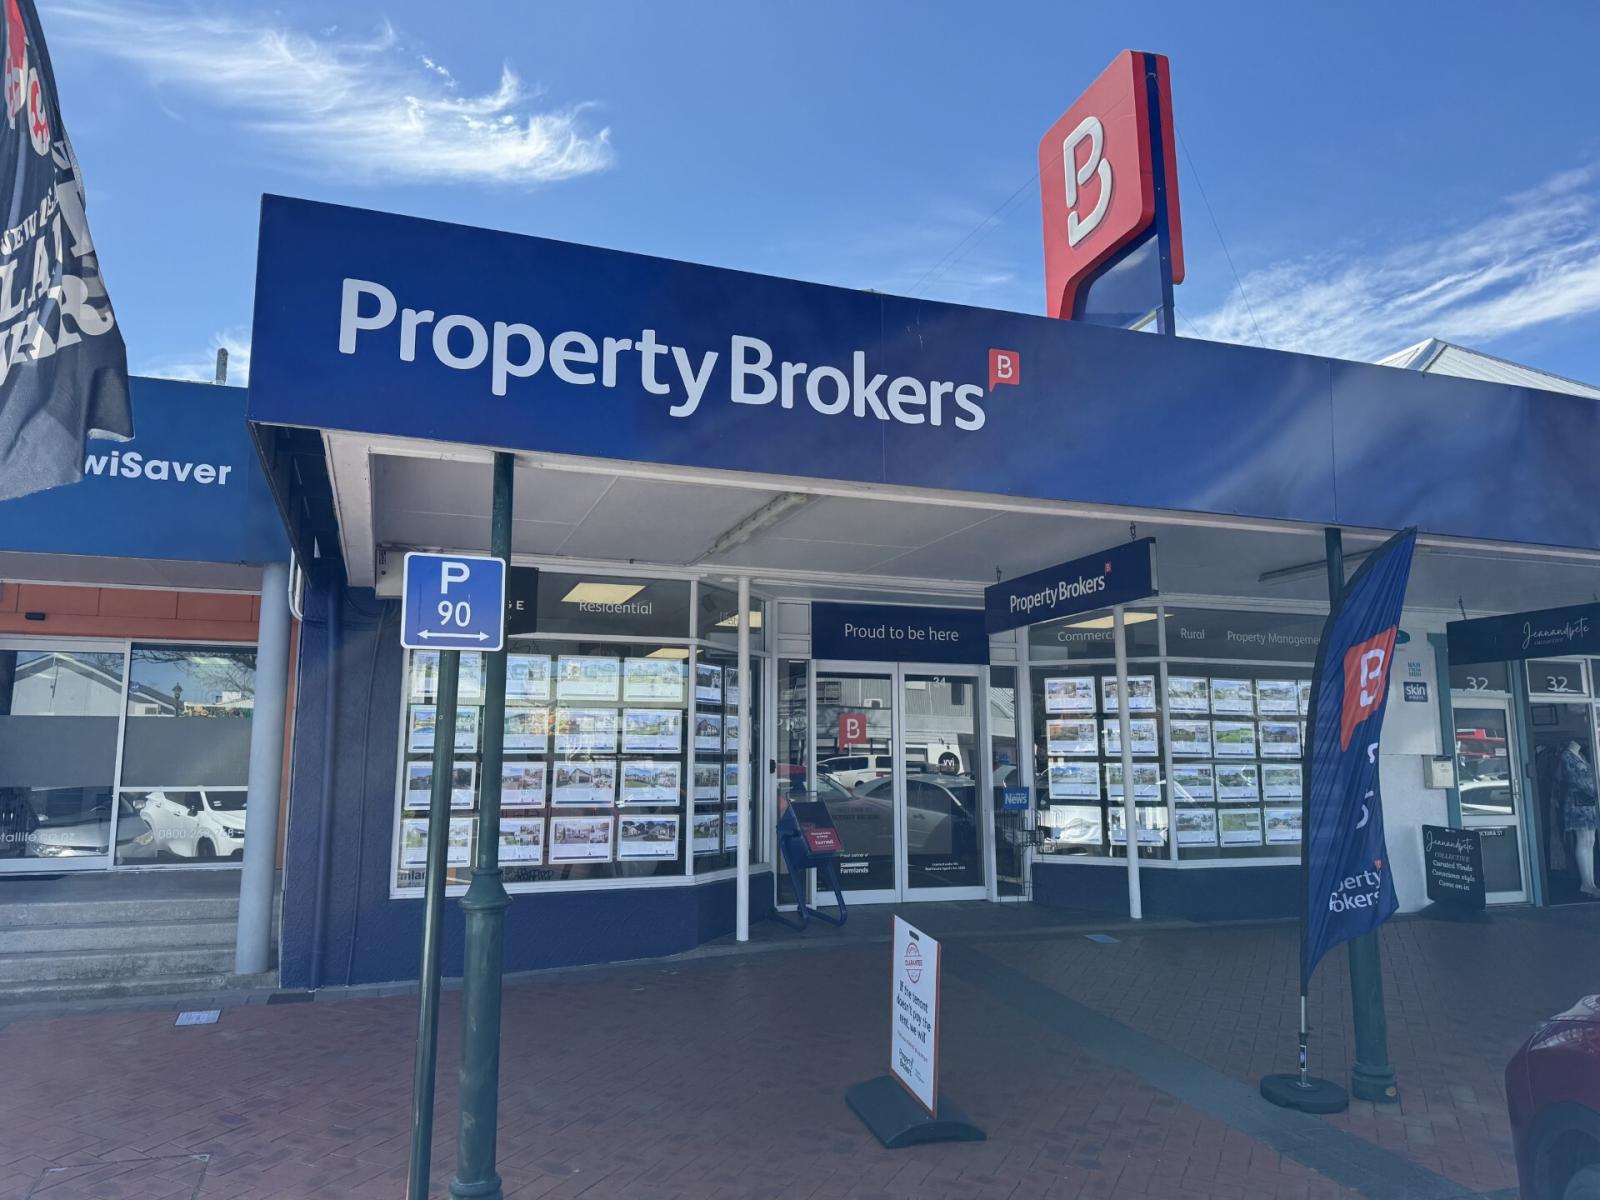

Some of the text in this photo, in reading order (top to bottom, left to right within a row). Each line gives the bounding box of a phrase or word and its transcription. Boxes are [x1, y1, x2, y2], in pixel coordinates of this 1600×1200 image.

[338, 277, 986, 431] Property Brokers
[83, 450, 232, 486] wiSaver
[440, 560, 471, 595] P
[1009, 573, 1106, 614] Property Brokers
[437, 600, 472, 627] 90
[578, 599, 653, 616] Residential
[844, 623, 960, 643] Proud to be here
[1180, 627, 1206, 640] Rural
[1227, 630, 1321, 647] Property Manageme
[1406, 683, 1426, 696] skin
[1466, 676, 1489, 691] 32
[1546, 676, 1569, 691] 32
